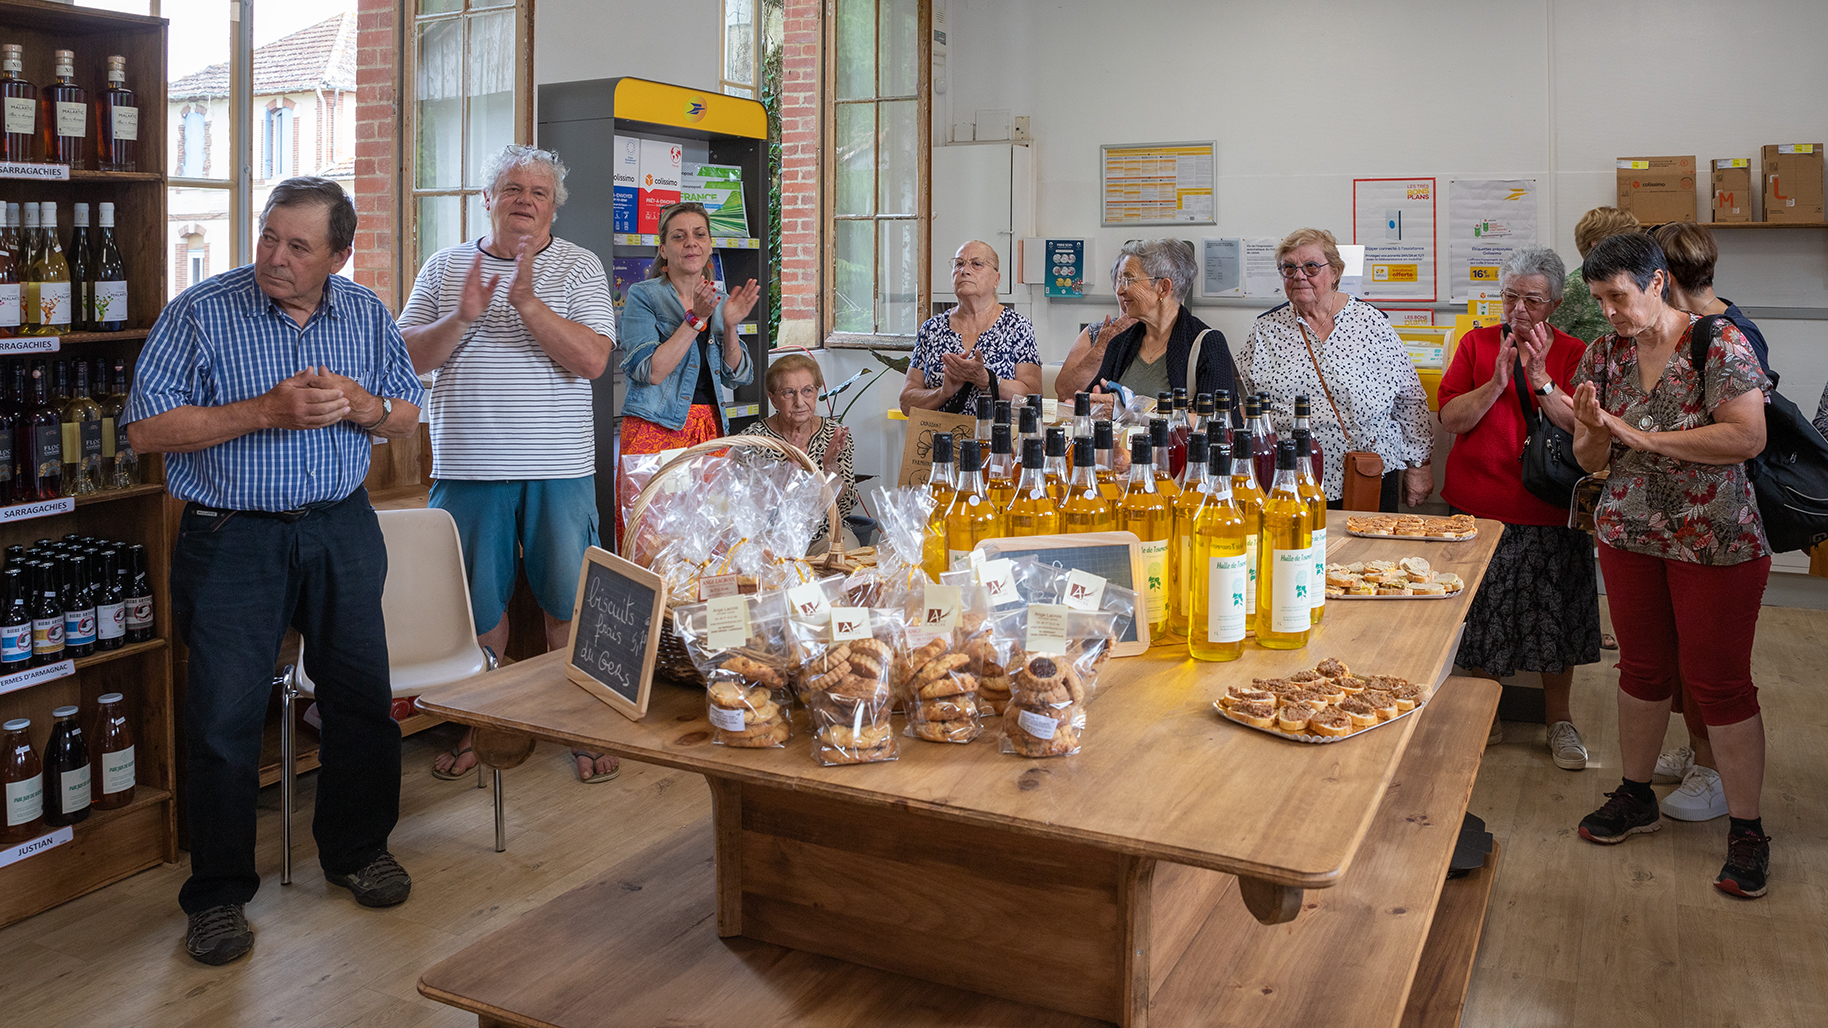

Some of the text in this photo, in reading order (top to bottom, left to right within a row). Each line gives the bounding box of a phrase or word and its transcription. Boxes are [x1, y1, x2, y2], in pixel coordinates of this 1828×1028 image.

[654, 178, 678, 186] colissimo
[1773, 178, 1788, 199] L
[681, 193, 717, 201] FRANCE
[1407, 187, 1430, 195] BONS
[1719, 192, 1734, 208] M
[1472, 269, 1484, 279] 16
[0, 340, 52, 351] RRAGACHIES
[43, 444, 60, 452] FLOC
[86, 438, 101, 446] FLOC
[0, 448, 11, 456] LOC
[4, 501, 67, 518] SARRAGACHIES
[588, 576, 635, 626] biscuits
[594, 613, 622, 647] frais
[580, 640, 594, 663] du
[0, 663, 68, 687] ERMES D'ARMAGNAC
[18, 837, 53, 856] JUSTIAN
